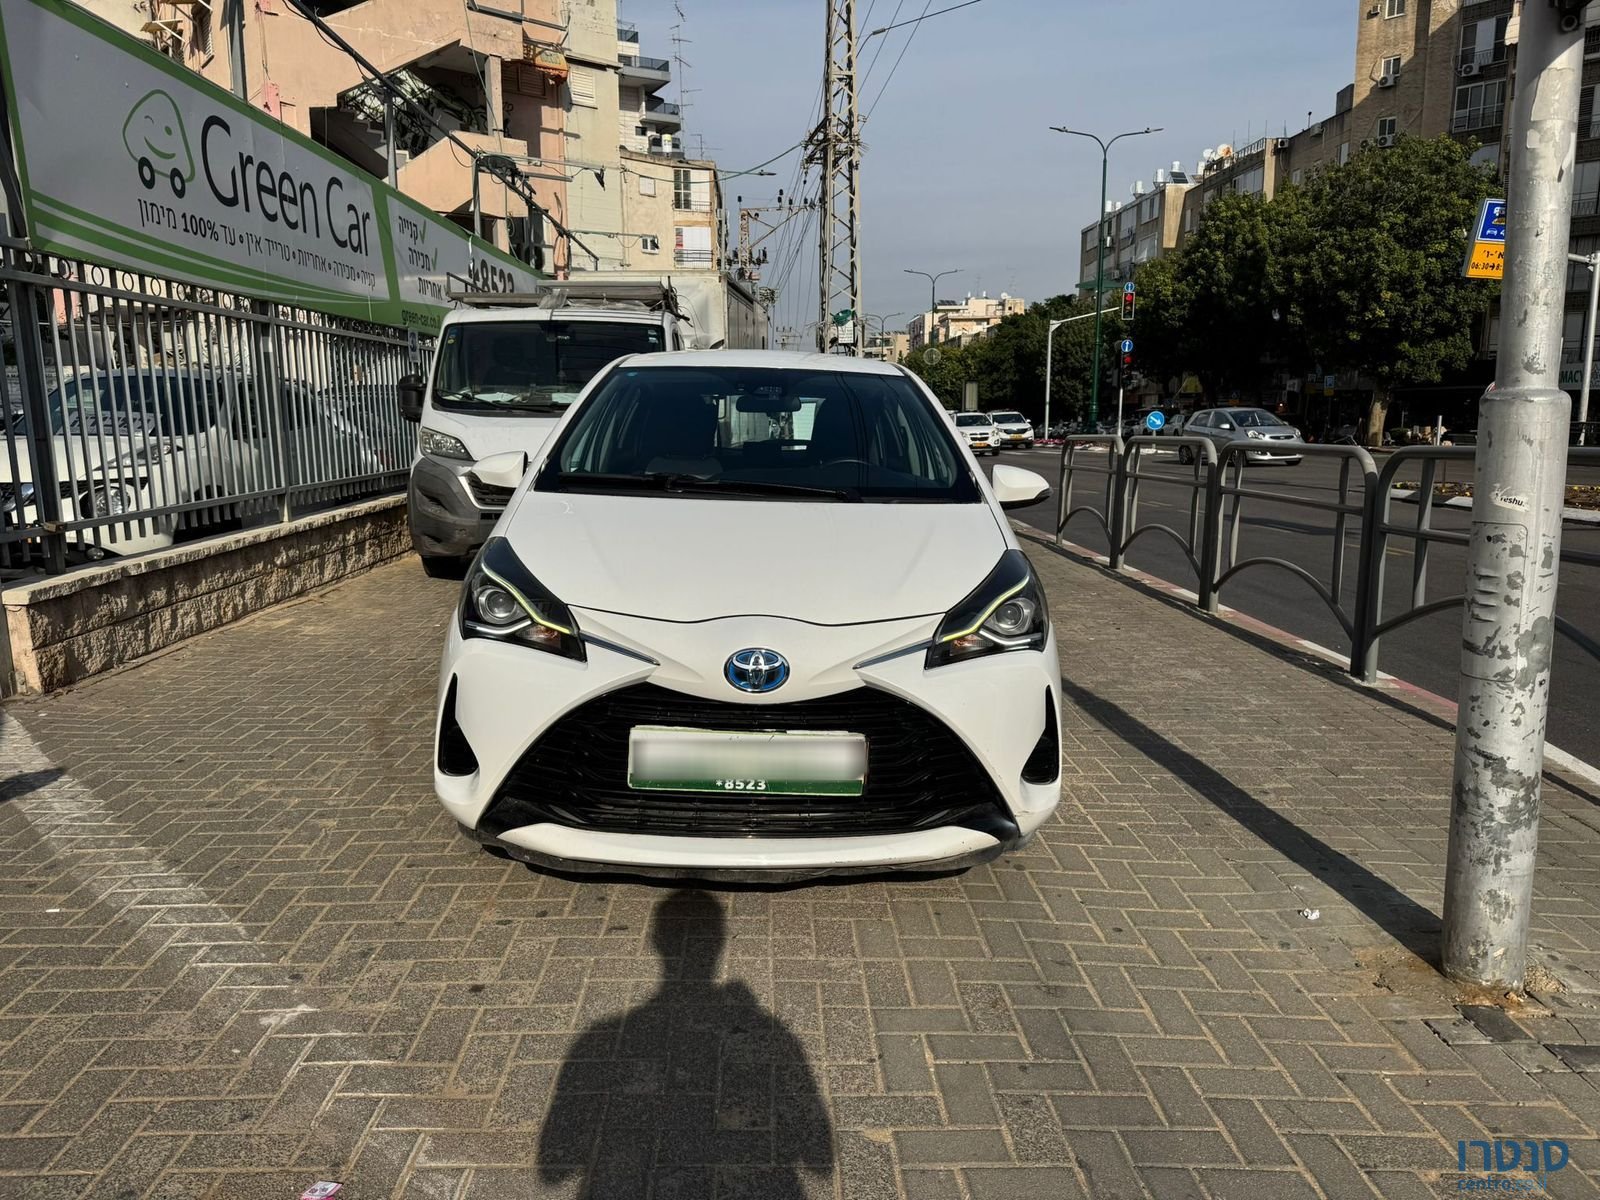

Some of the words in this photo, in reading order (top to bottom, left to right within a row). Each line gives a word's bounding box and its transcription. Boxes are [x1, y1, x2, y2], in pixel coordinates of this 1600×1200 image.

[201, 115, 320, 239] Green
[326, 176, 371, 257] Car
[138, 198, 177, 228] מימון
[181, 212, 219, 242] 100%
[220, 224, 236, 246] עד
[398, 215, 418, 246] קנייה
[245, 232, 263, 256] אין
[265, 238, 291, 261] טרייד
[297, 248, 327, 273] אחריות
[333, 260, 356, 281] מכירה
[408, 247, 431, 272] מכירה
[418, 276, 443, 301] אחריות
[1561, 370, 1584, 384] MACY
